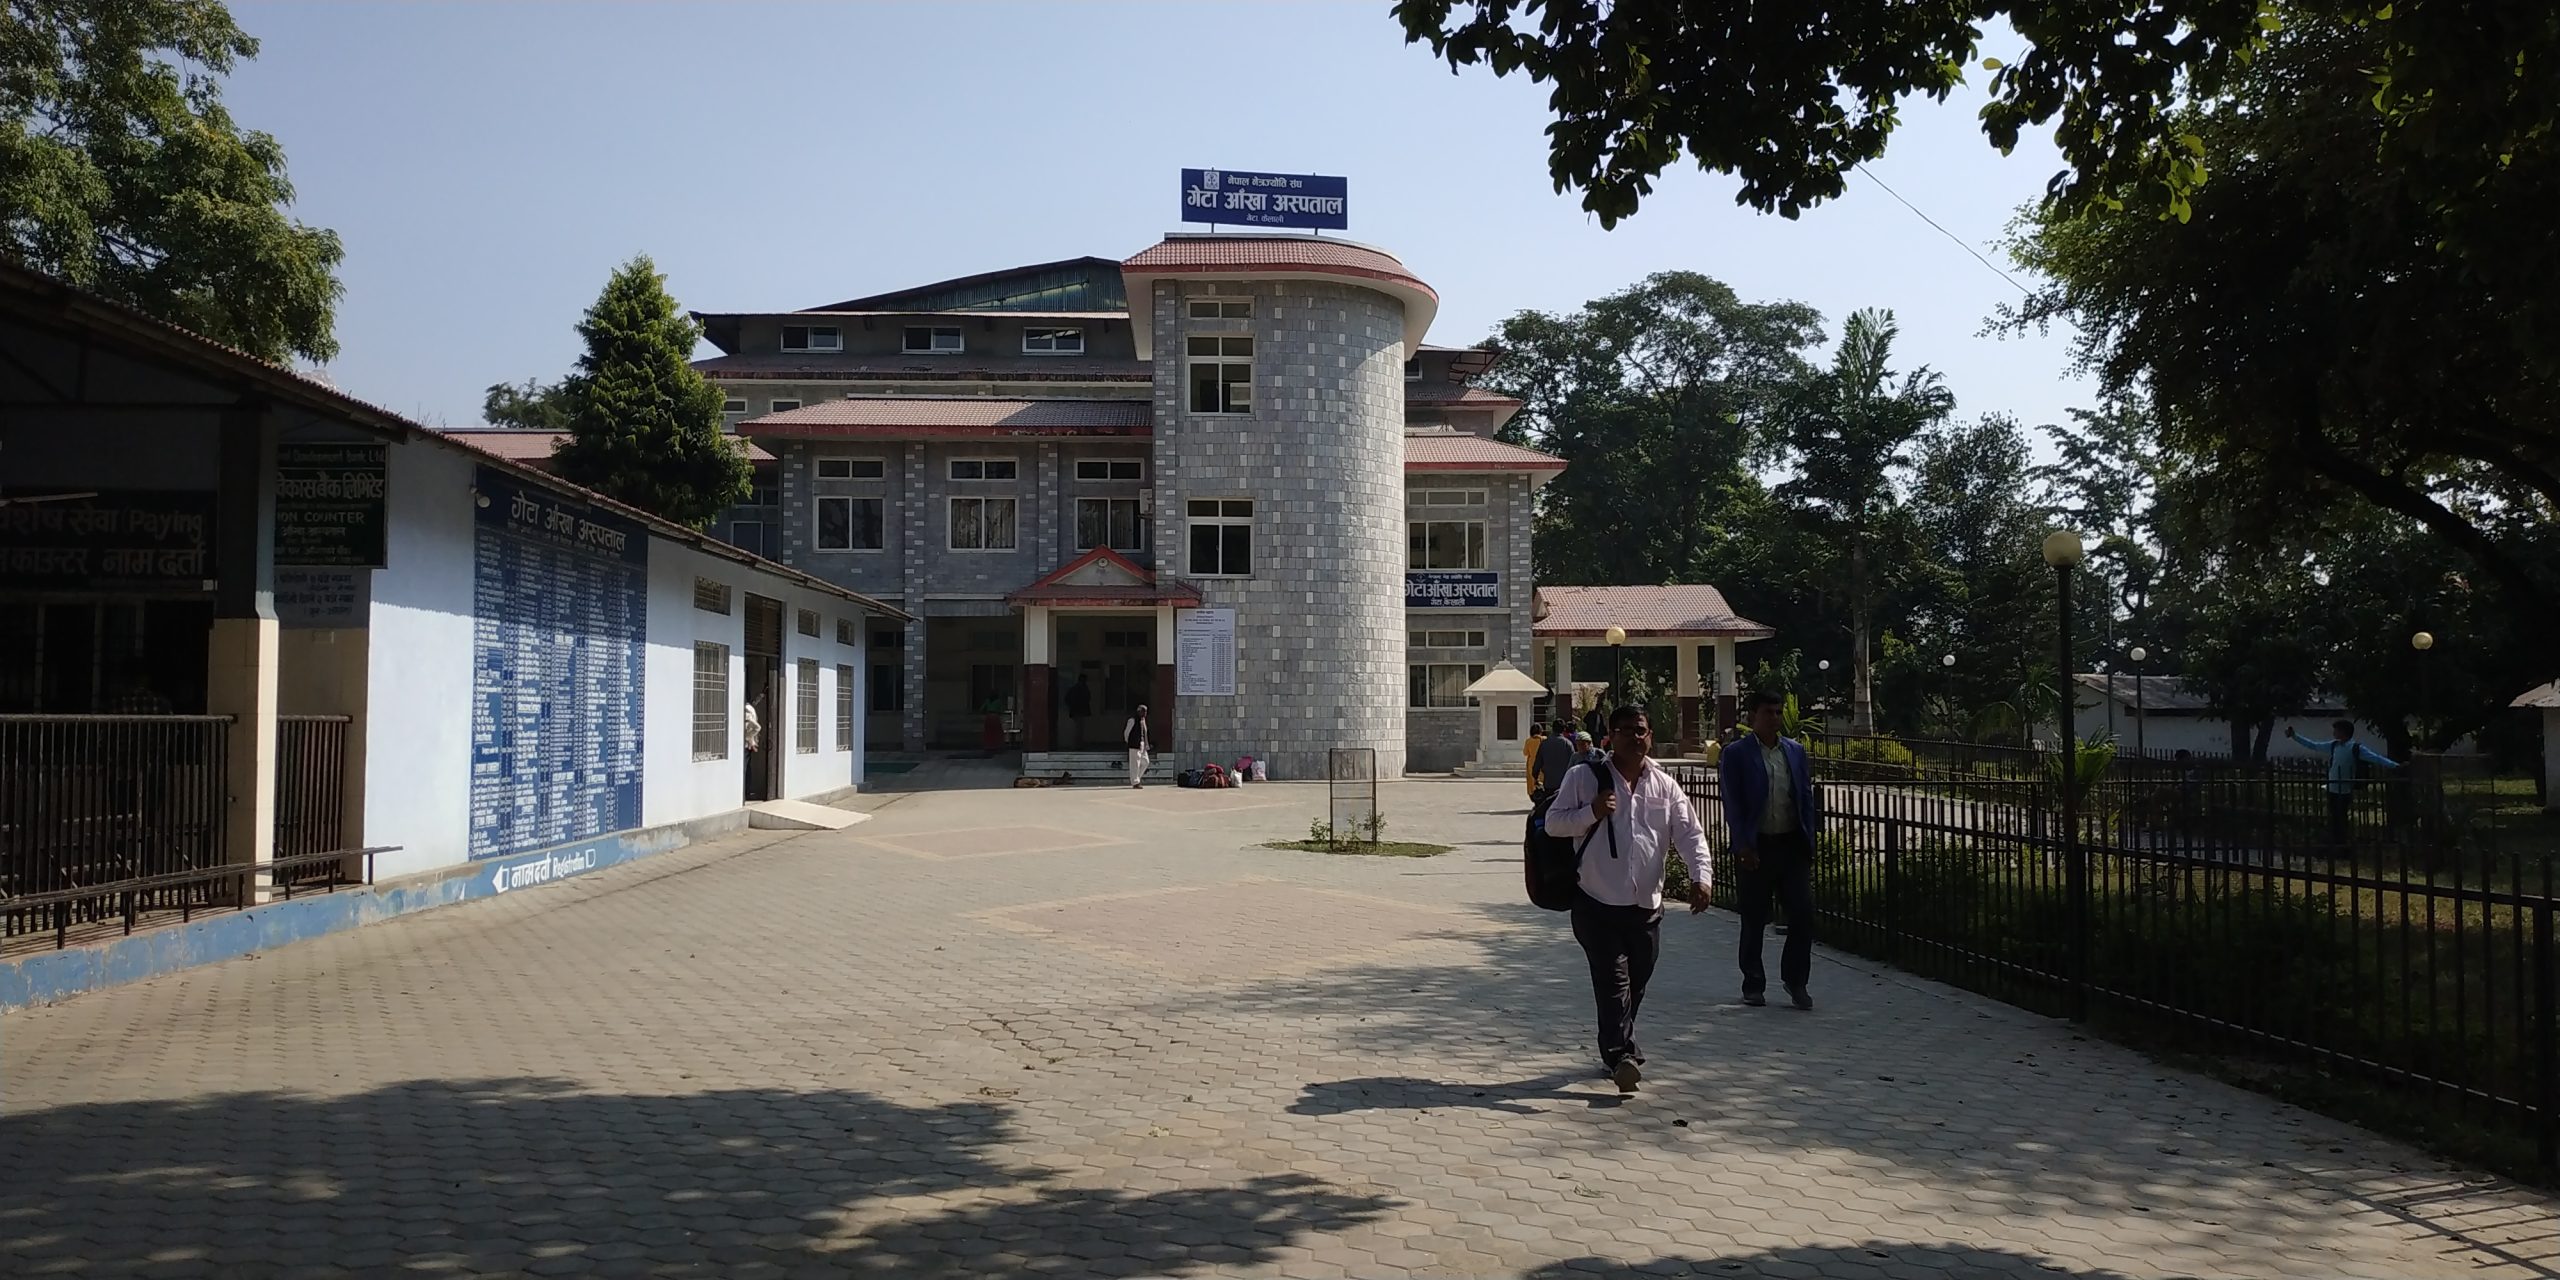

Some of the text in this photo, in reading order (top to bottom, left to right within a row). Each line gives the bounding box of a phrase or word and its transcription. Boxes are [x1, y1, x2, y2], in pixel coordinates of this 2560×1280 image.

[1227, 174, 1250, 186] नेपाल
[1187, 185, 1343, 215] गेटा आँखा अस्पताल
[342, 471, 385, 500] लिमिटेड
[304, 511, 365, 524] COUNTER
[511, 489, 540, 525] गेटा
[577, 518, 627, 551] अस्पताल
[1452, 583, 1498, 598] अस्पताल
